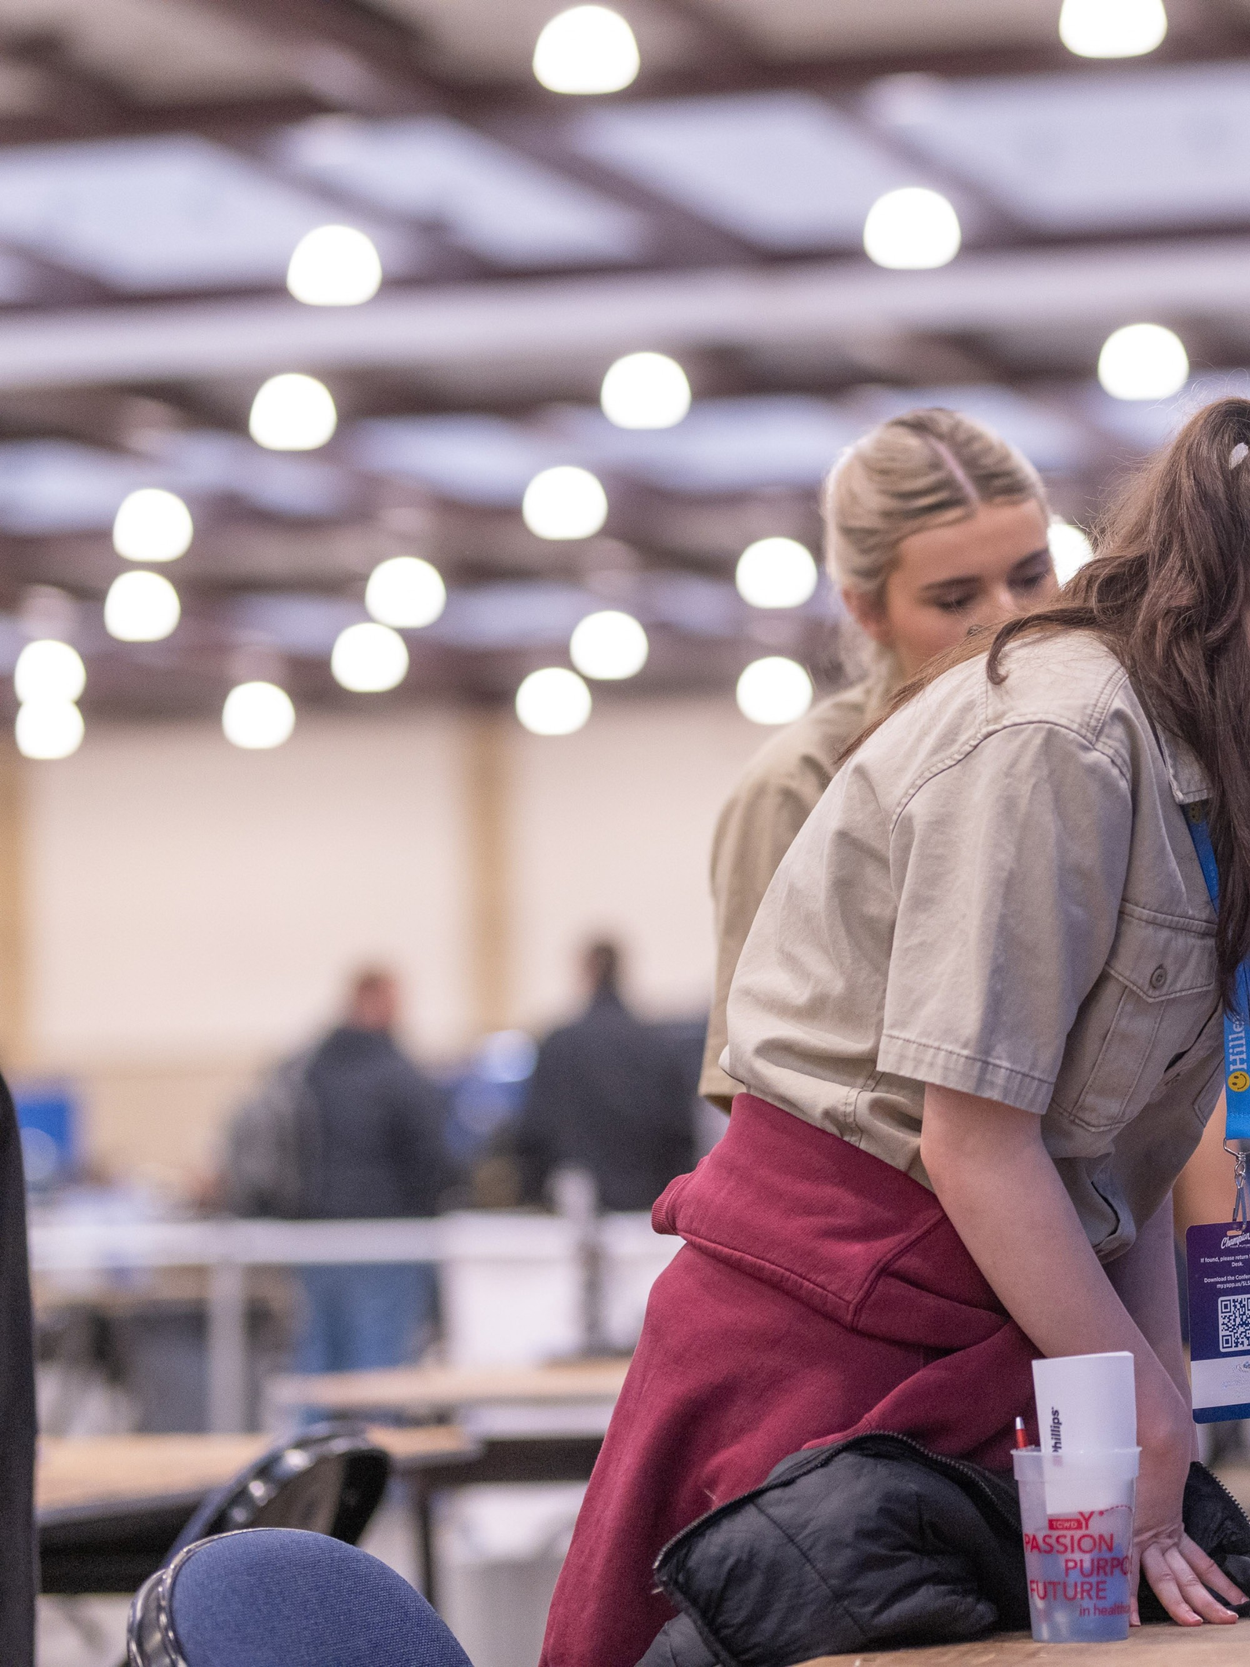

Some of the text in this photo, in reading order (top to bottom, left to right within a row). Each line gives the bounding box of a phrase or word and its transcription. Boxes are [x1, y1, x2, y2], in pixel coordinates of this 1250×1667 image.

[1024, 1533, 1114, 1554] PASSION
[1029, 1580, 1107, 1601] FUTURE
[1079, 1604, 1091, 1617] in
